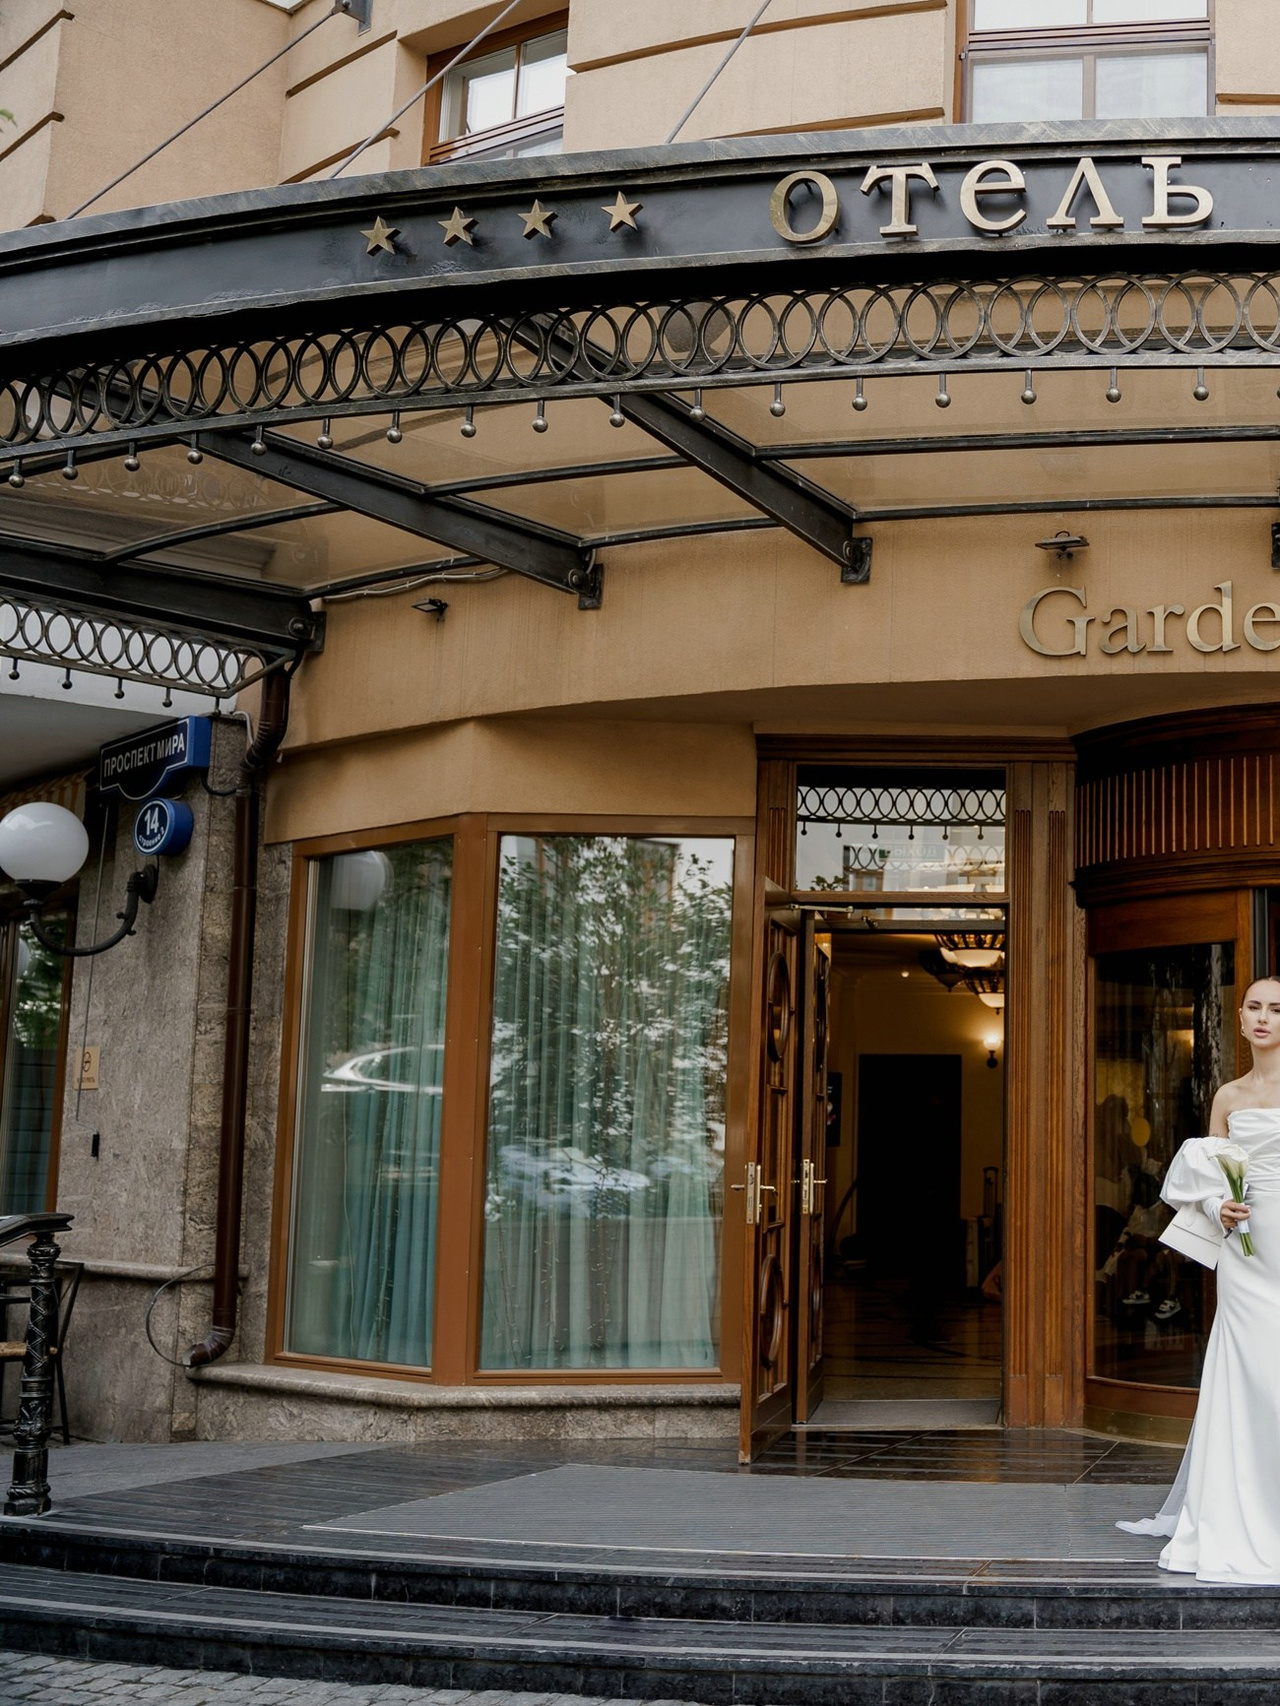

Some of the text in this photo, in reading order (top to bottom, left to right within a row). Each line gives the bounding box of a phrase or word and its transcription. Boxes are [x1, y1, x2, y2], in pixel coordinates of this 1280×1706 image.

[104, 733, 185, 777] ПРОСПЕКТ МИРА
[144, 807, 159, 835] 14
